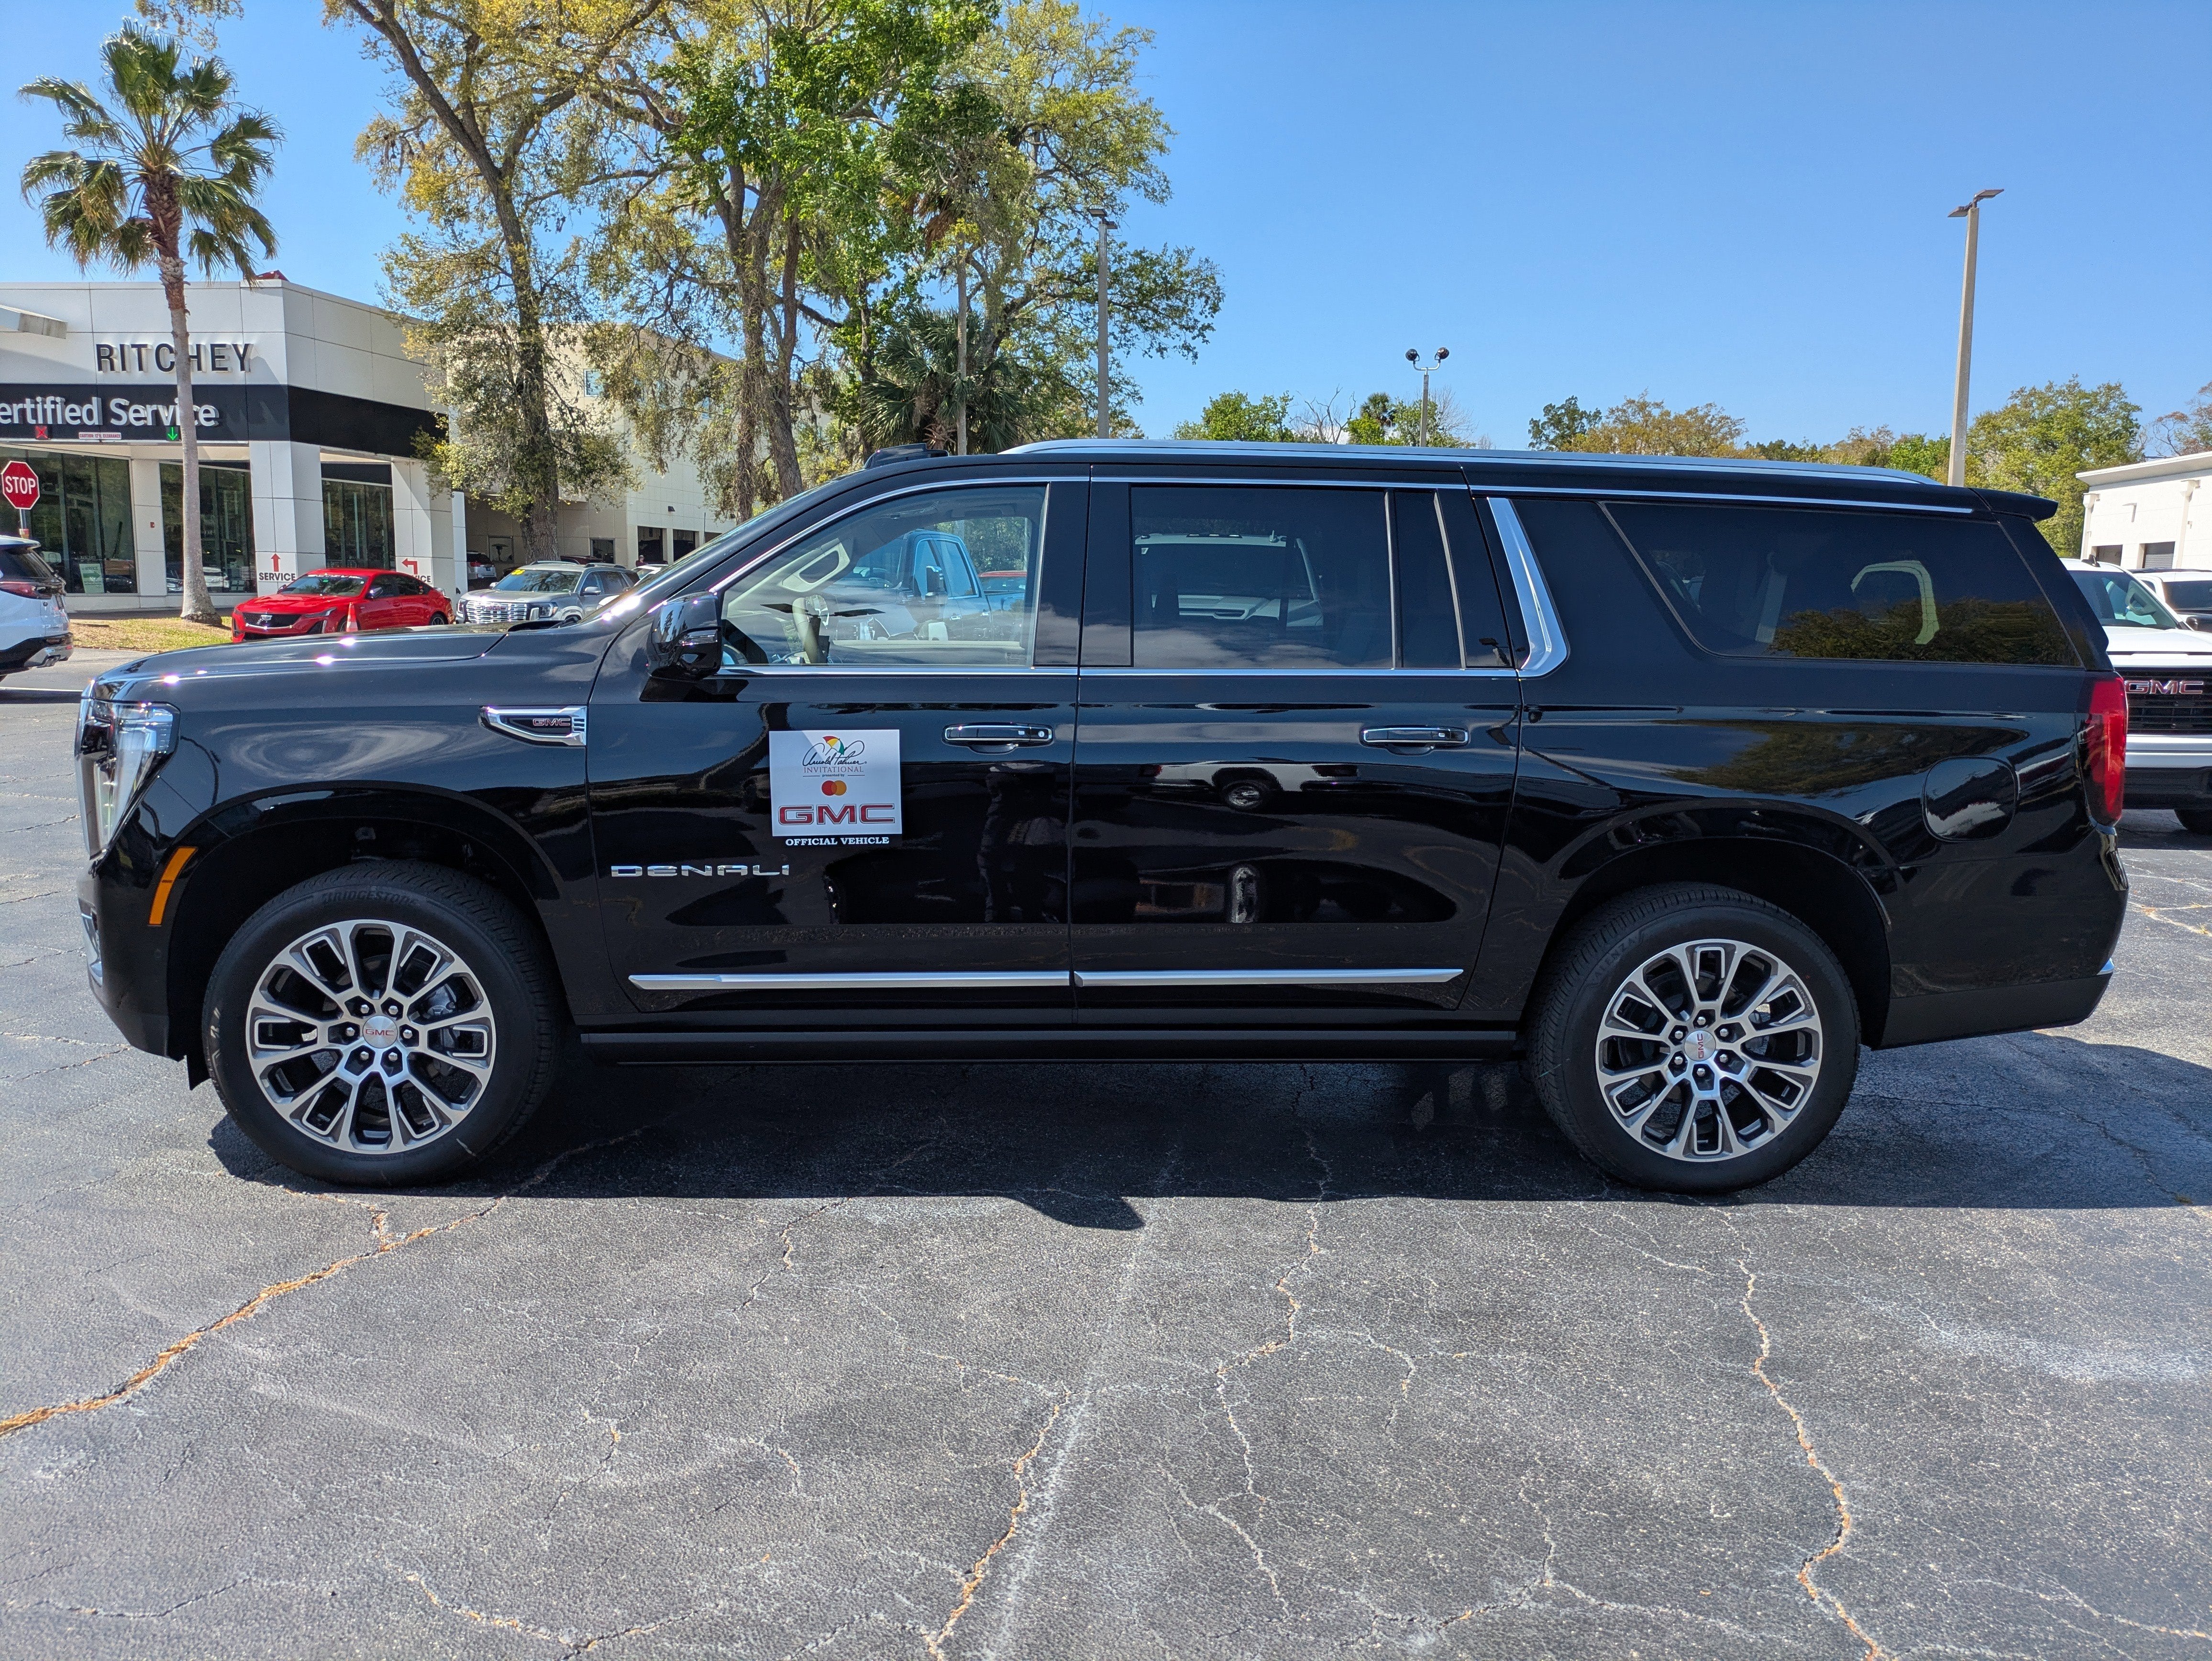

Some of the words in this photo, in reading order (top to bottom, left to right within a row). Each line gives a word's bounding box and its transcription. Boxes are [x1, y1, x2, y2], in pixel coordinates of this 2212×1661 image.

[96, 343, 251, 372] RITCHEY
[110, 398, 219, 426] Servie
[5, 476, 36, 495] STOP
[259, 572, 296, 581] SERVICE
[2124, 679, 2204, 694] GMC
[532, 718, 571, 726] GMC
[802, 742, 837, 766] Arnold
[778, 803, 895, 825] GMC
[785, 838, 837, 846] OFFICIAL
[840, 837, 889, 845] VEHICLE
[611, 864, 789, 877] DENALI
